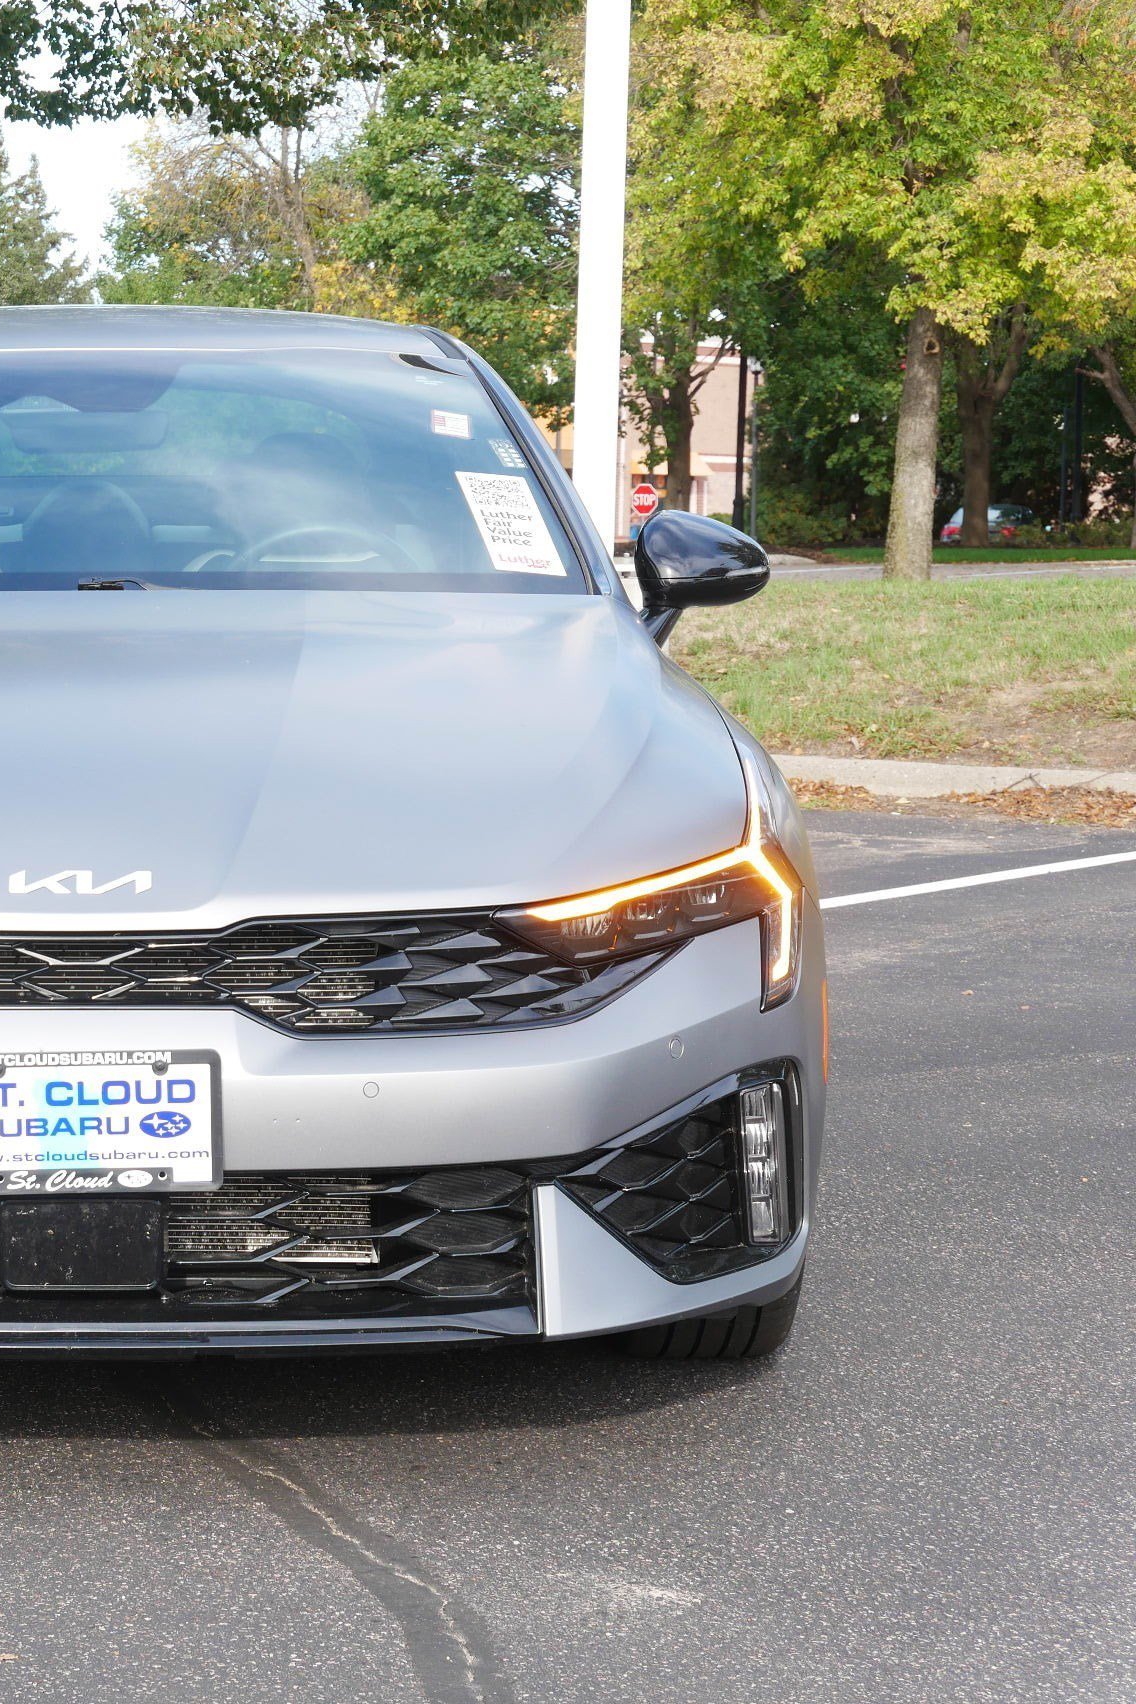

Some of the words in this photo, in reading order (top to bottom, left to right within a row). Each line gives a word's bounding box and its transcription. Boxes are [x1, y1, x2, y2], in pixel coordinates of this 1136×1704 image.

[633, 493, 656, 506] STOP
[480, 509, 532, 521] Luther
[483, 518, 513, 527] Fair
[486, 526, 533, 537] Value
[490, 535, 532, 546] Price
[498, 553, 551, 569] Luther
[9, 869, 152, 894] KIA
[45, 1079, 196, 1107] CLOUD
[6, 1171, 41, 1190] St.
[45, 1170, 113, 1192] Cloud
